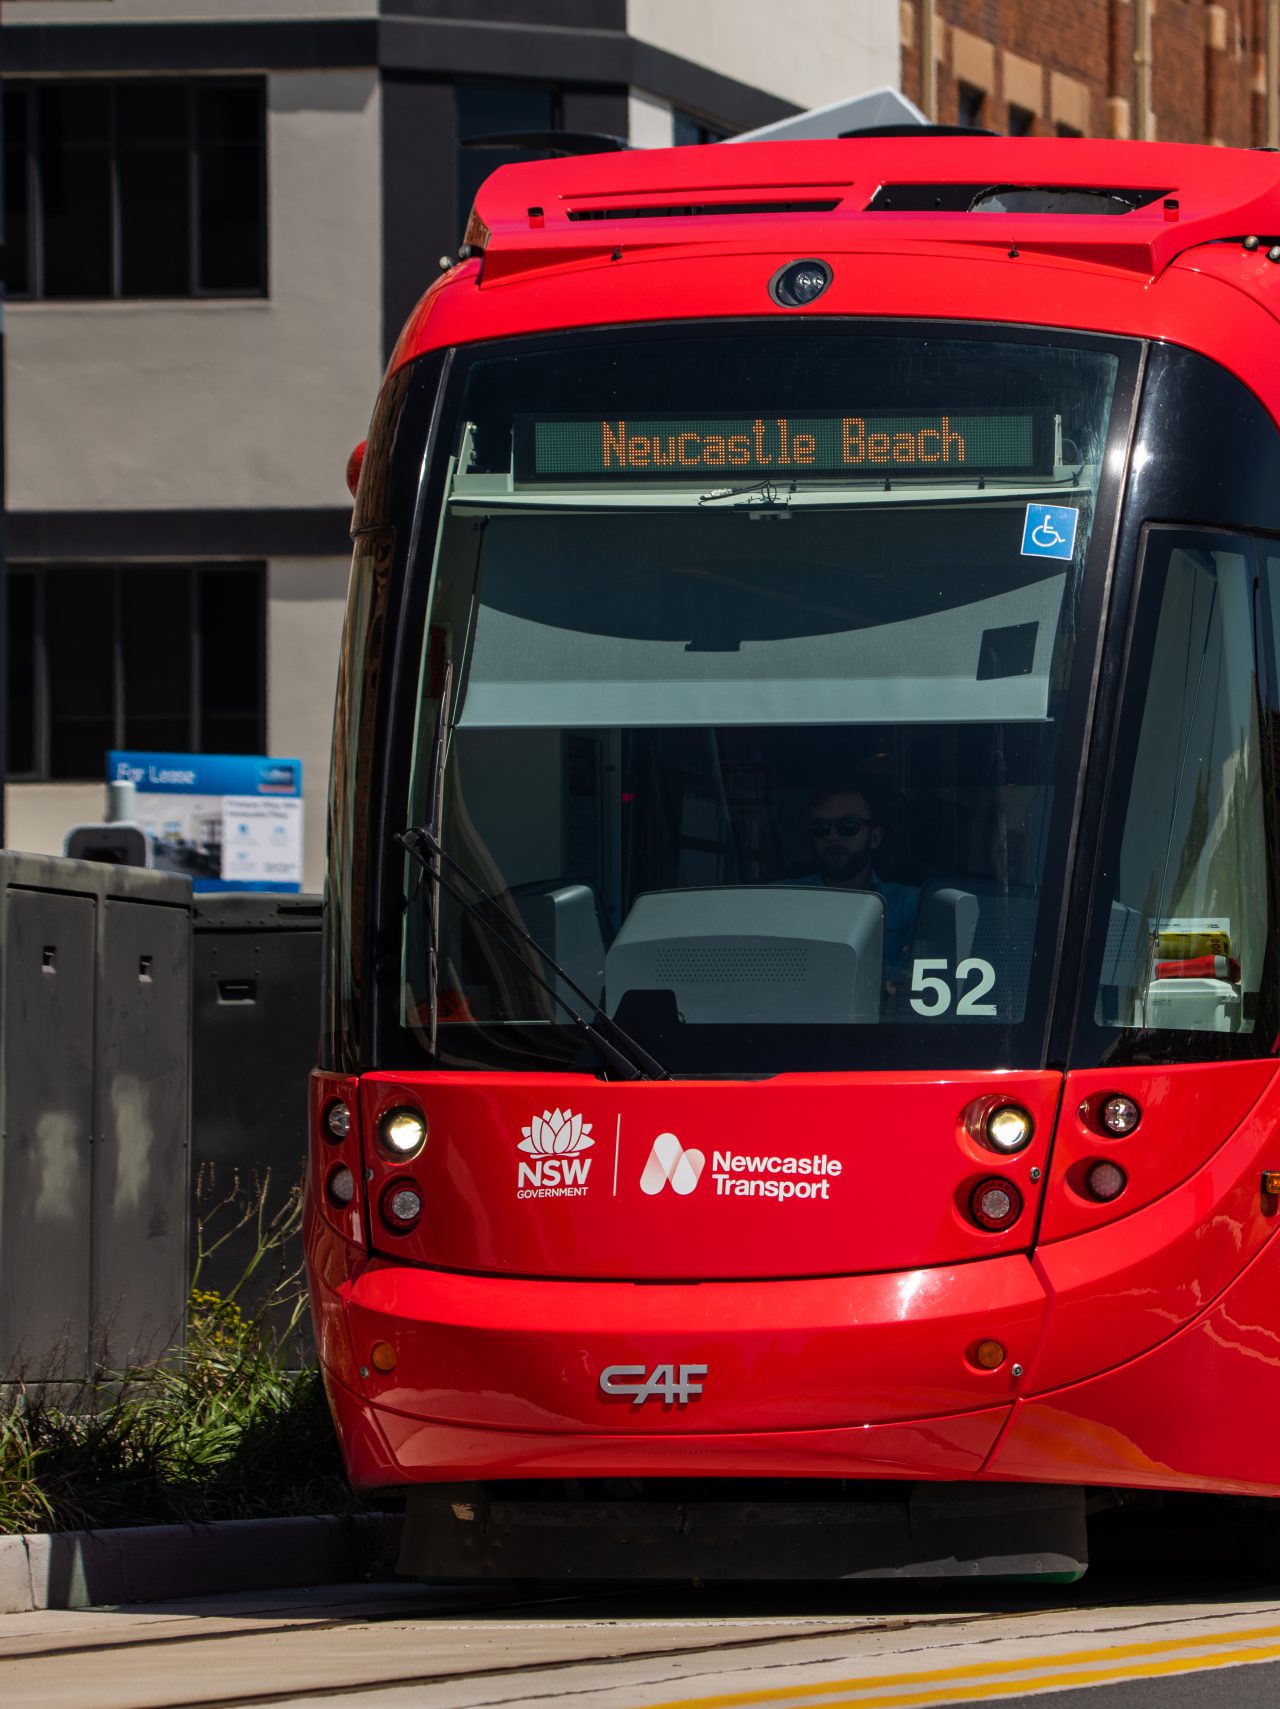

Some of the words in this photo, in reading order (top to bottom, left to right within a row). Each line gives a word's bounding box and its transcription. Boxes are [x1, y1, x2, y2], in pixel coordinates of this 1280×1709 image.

[602, 419, 816, 466] Newcastle
[842, 416, 965, 463] Beach
[117, 762, 144, 782] For
[149, 764, 195, 785] Lease
[909, 957, 997, 1016] 52
[516, 1159, 593, 1188] NSW
[711, 1151, 843, 1177] Newcastle
[516, 1187, 589, 1199] GOVERNMENT
[711, 1174, 830, 1202] Transport
[599, 1364, 708, 1404] CAF
